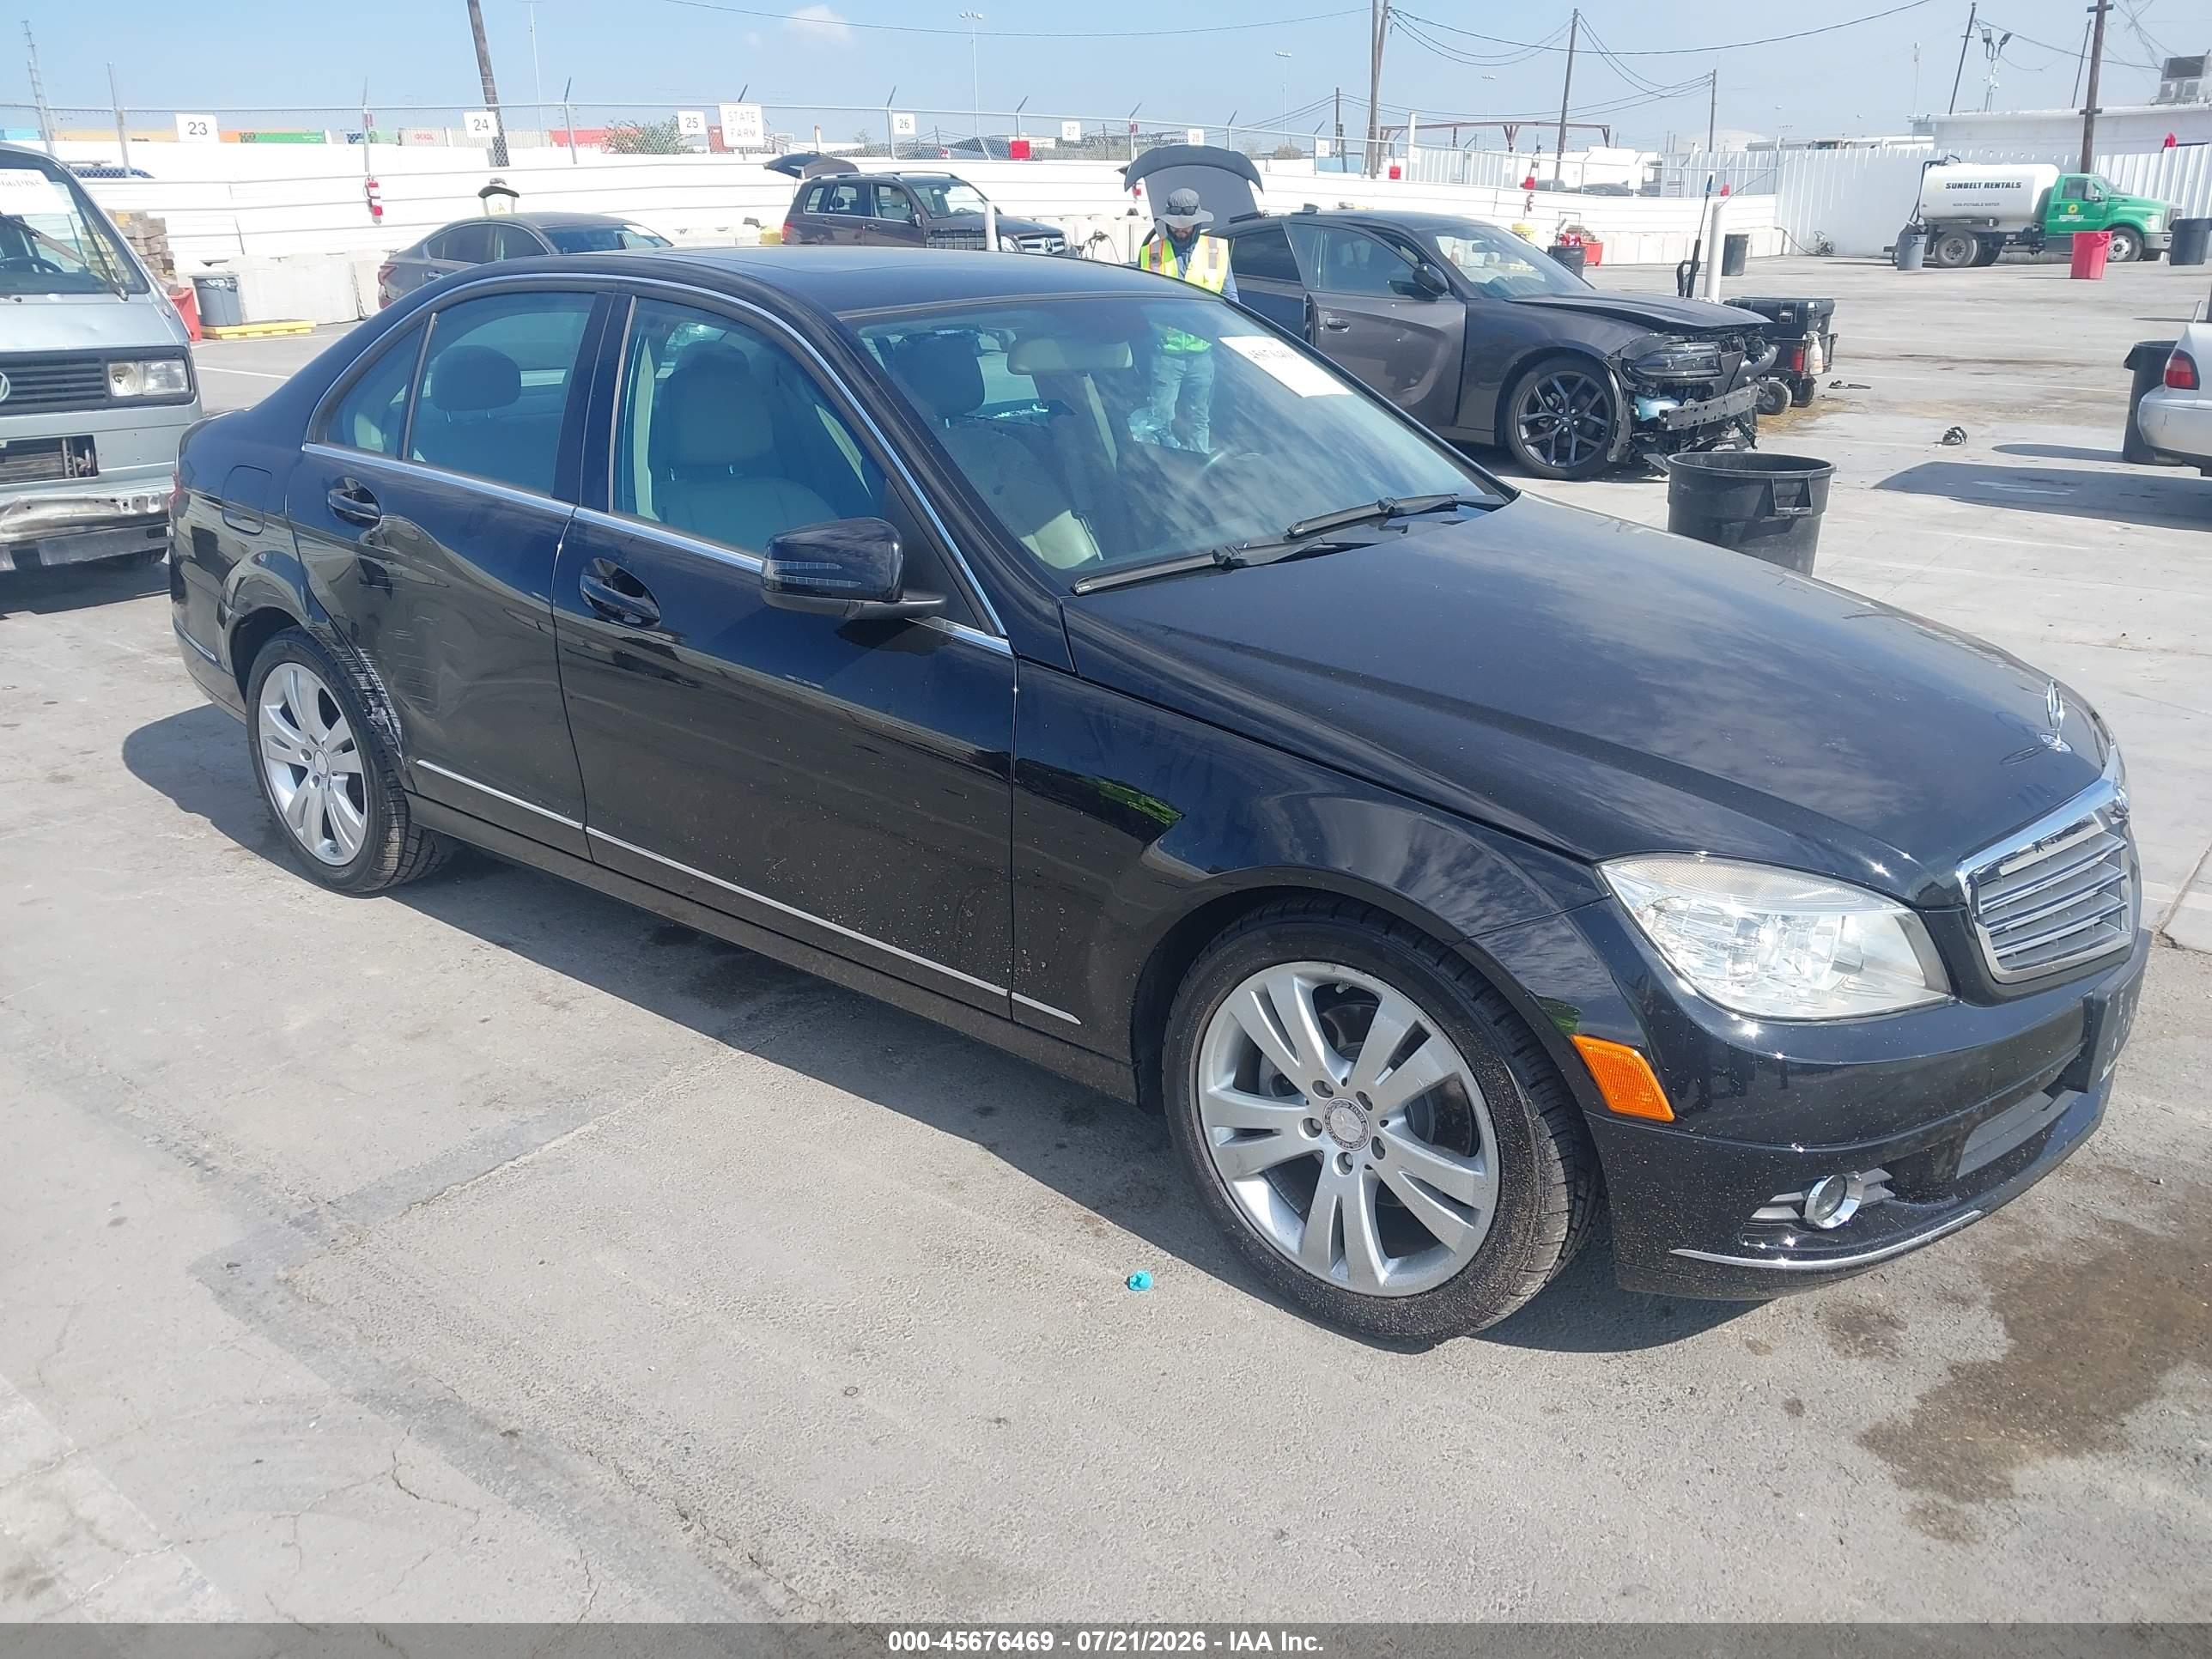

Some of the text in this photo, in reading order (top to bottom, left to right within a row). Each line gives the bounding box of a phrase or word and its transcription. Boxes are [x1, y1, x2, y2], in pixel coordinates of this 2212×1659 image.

[685, 117, 699, 129] 25
[727, 111, 757, 124] STATE
[187, 121, 208, 136] 23
[473, 118, 489, 131] 24
[899, 118, 910, 130] 26
[730, 128, 757, 138] FARM
[1066, 125, 1077, 137] 27
[1945, 181, 1982, 190] SUNBELT
